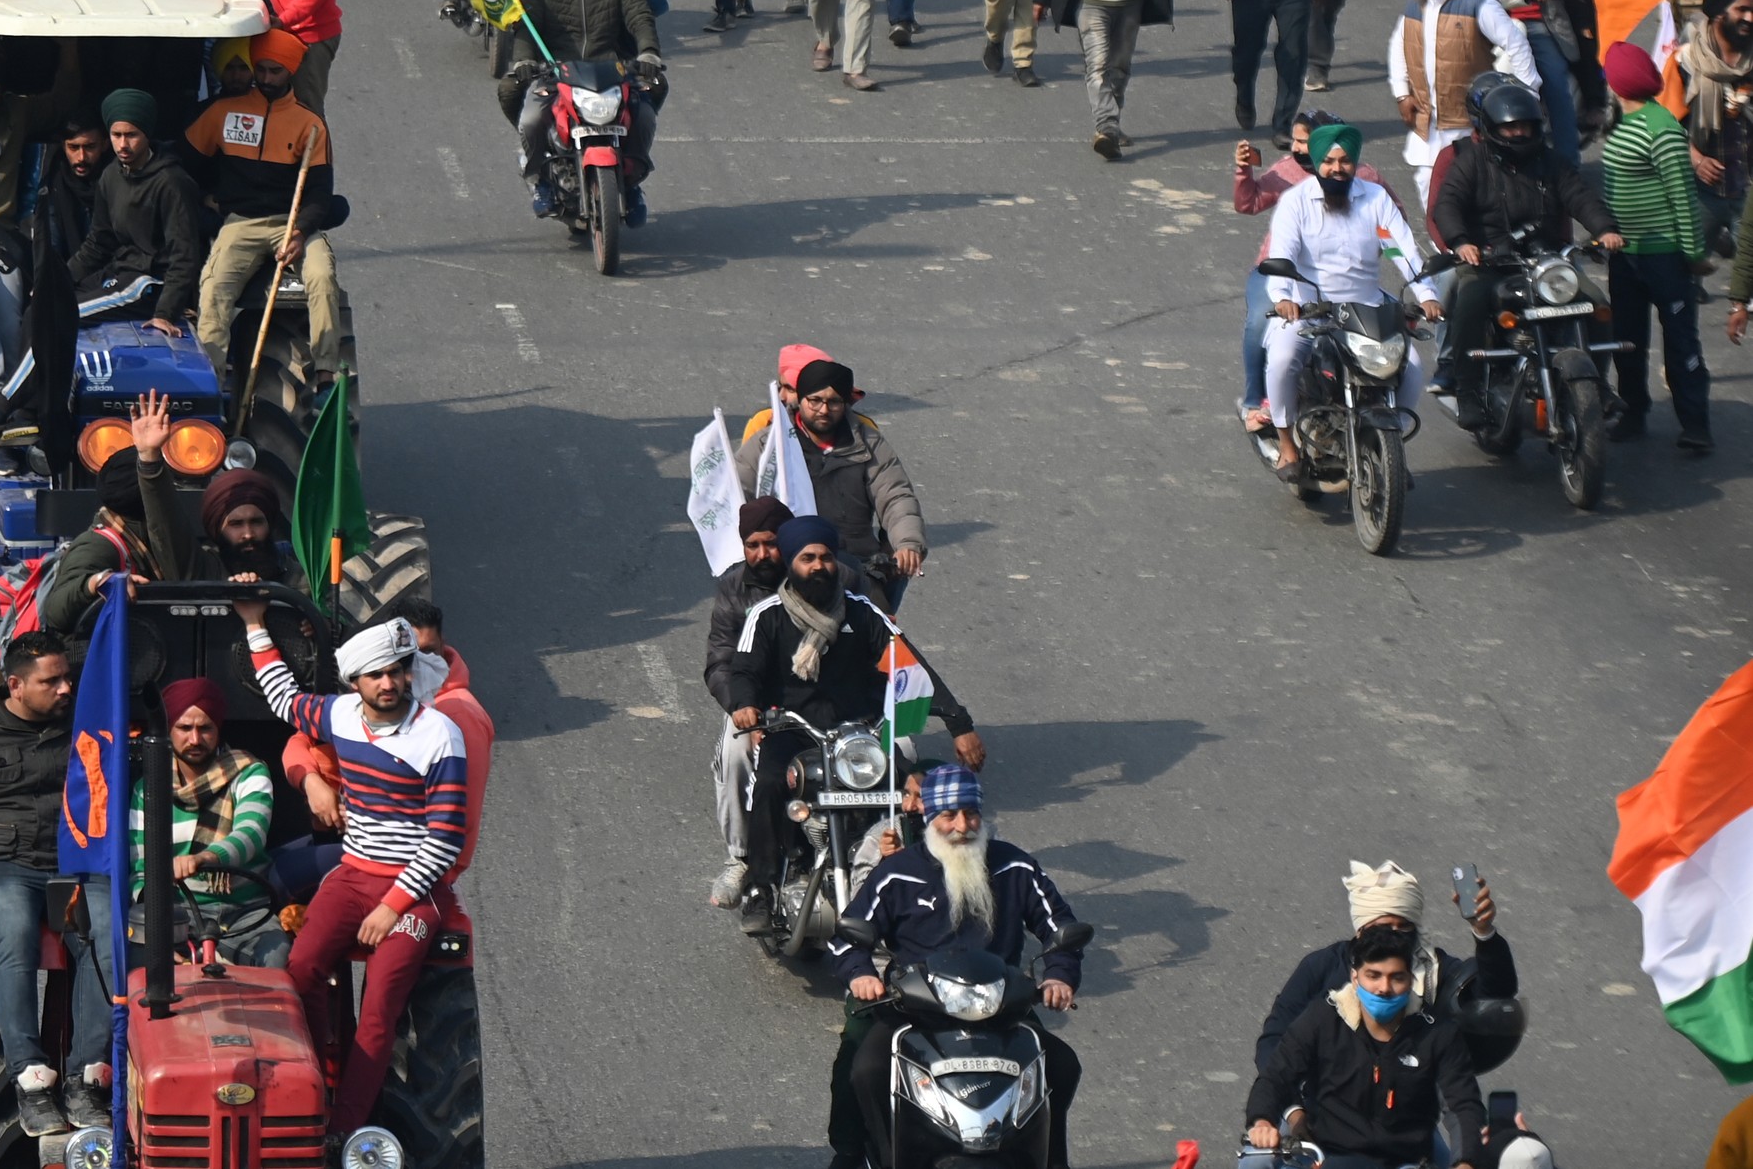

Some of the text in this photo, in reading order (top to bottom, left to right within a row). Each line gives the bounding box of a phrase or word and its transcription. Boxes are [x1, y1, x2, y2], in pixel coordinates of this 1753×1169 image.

[226, 129, 260, 144] KISAN
[103, 401, 193, 411] FARAC
[388, 914, 428, 942] AP
